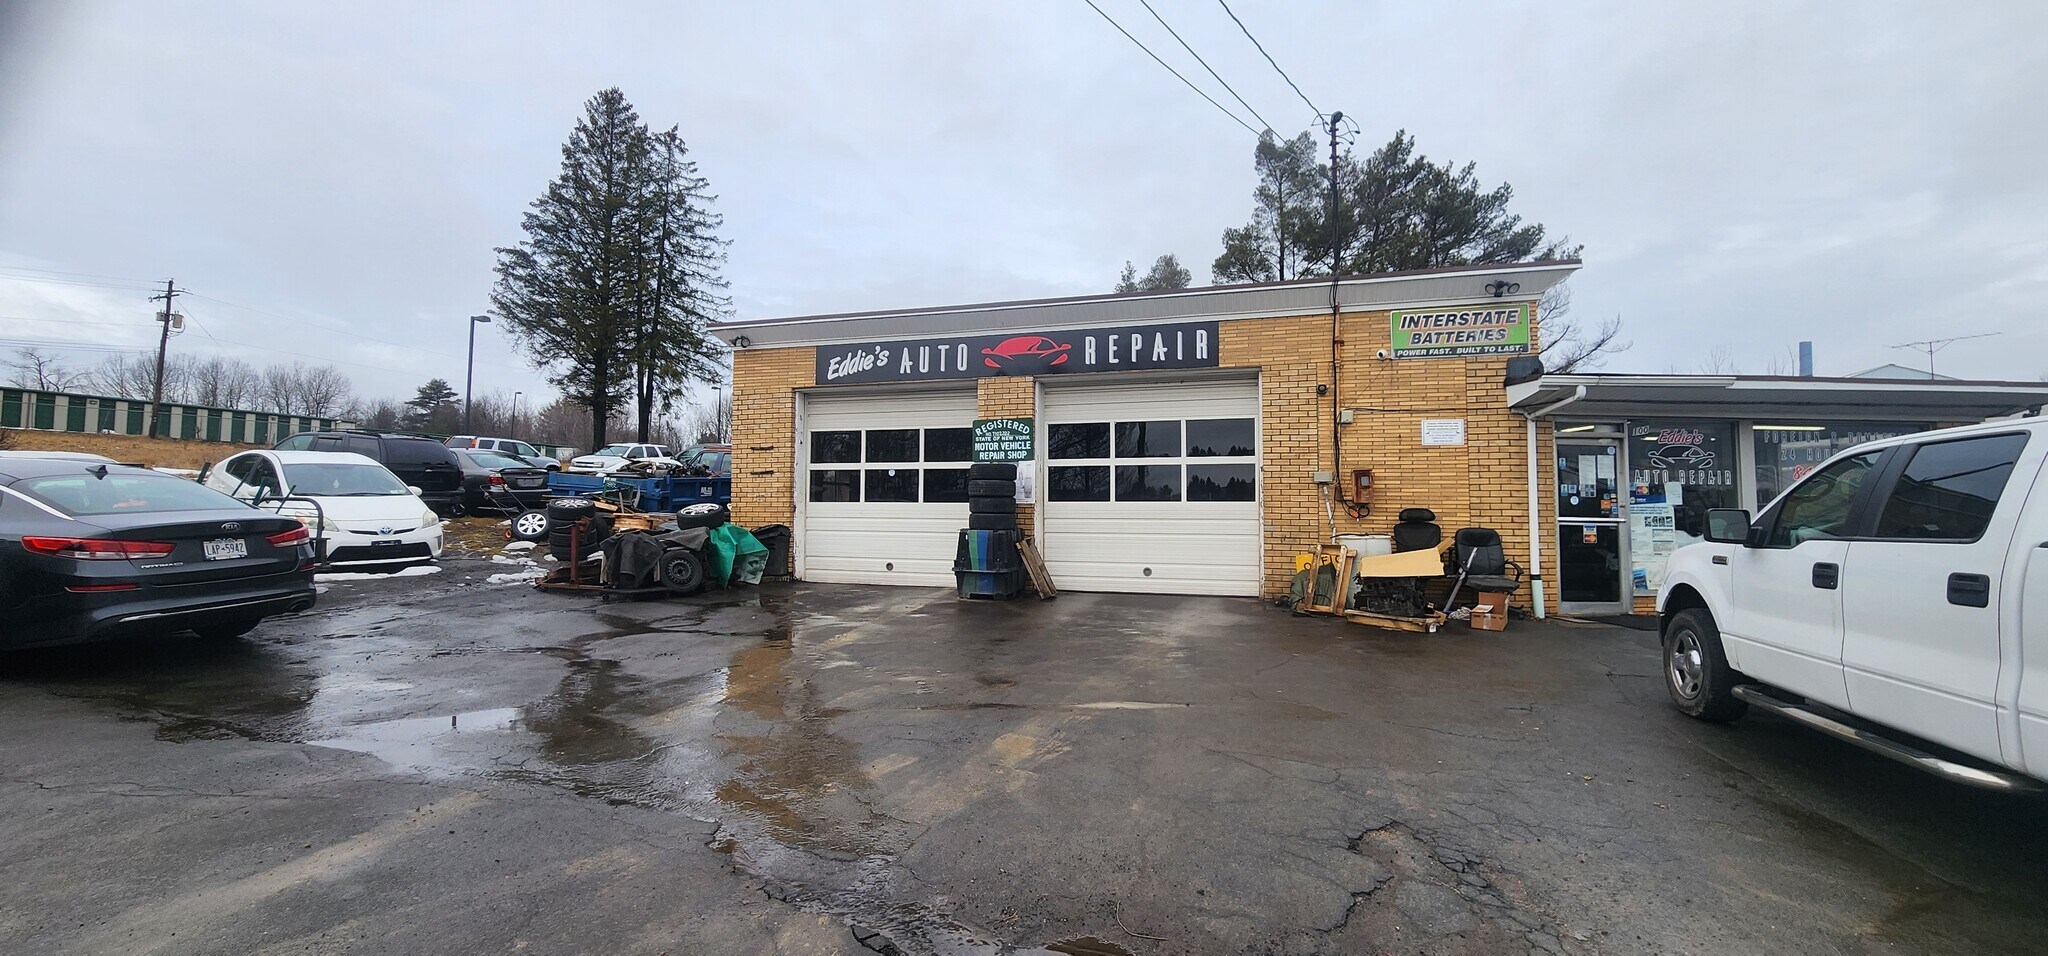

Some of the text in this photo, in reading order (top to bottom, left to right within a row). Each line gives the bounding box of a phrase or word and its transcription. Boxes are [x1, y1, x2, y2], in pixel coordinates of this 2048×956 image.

[1400, 309, 1520, 329] INTERSTATE
[1410, 328, 1508, 345] BATTERIES
[827, 329, 1209, 380] Eddie's AUTO REPAIR
[975, 420, 1030, 436] REGISTERED
[1658, 429, 1703, 444] Eddie's
[1764, 431, 1820, 443] FOREIGN
[975, 441, 1031, 451] MOTOR VEHICLE
[980, 450, 1027, 460] REPAIR SHOP
[1781, 449, 1796, 460] 24
[1635, 470, 1732, 485] AUTO REPAIR
